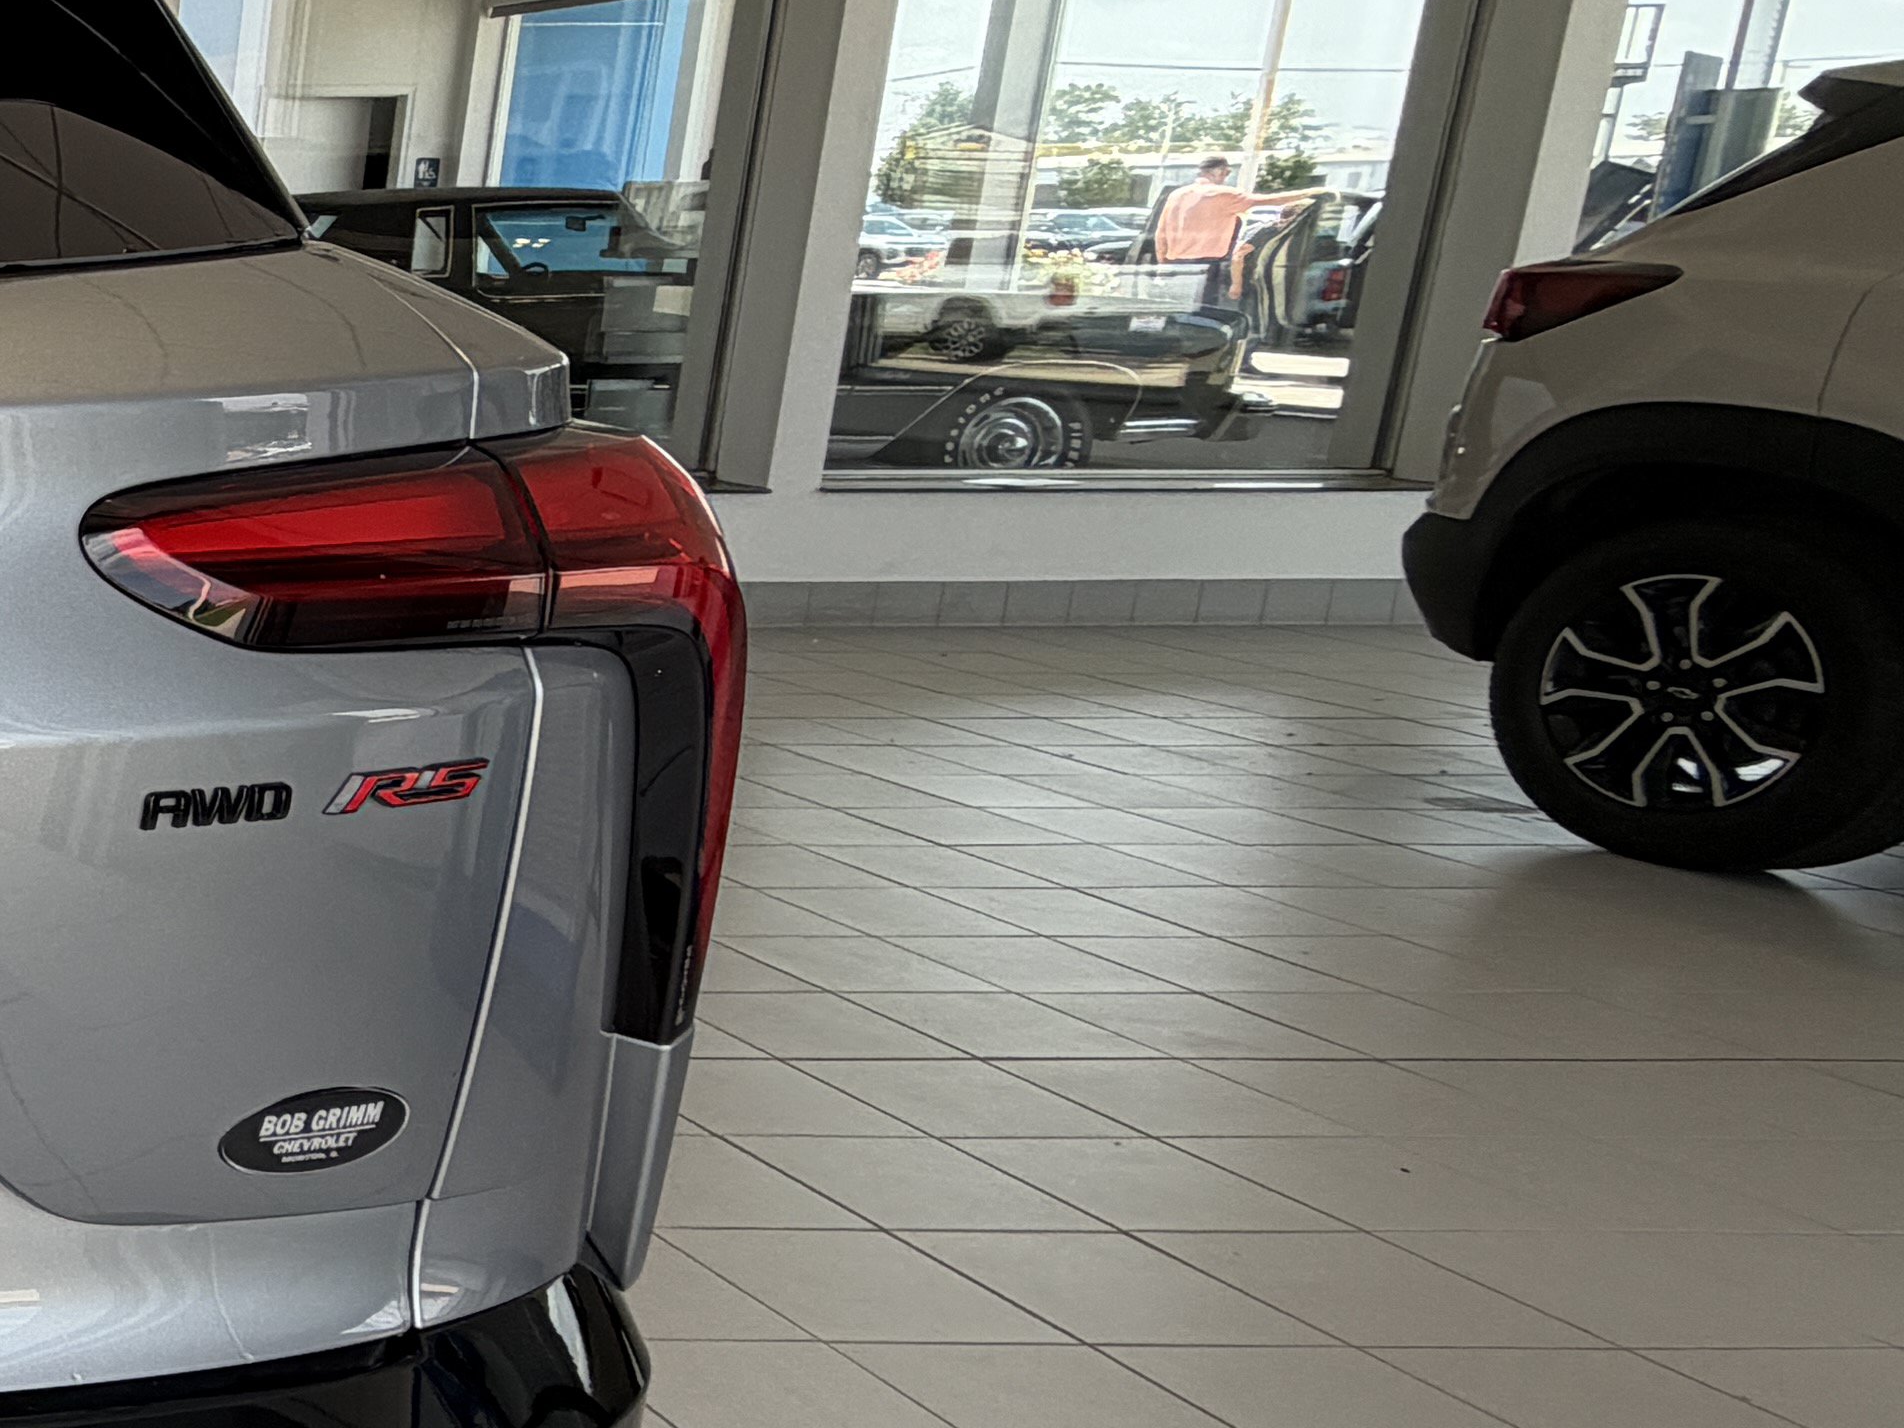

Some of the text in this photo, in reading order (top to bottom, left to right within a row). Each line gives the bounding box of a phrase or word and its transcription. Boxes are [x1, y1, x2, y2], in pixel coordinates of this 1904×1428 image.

[139, 781, 292, 831] AWD
[322, 757, 490, 816] RS
[259, 1101, 385, 1137] BOB GRIMM
[272, 1132, 358, 1155] CHEVROLET
